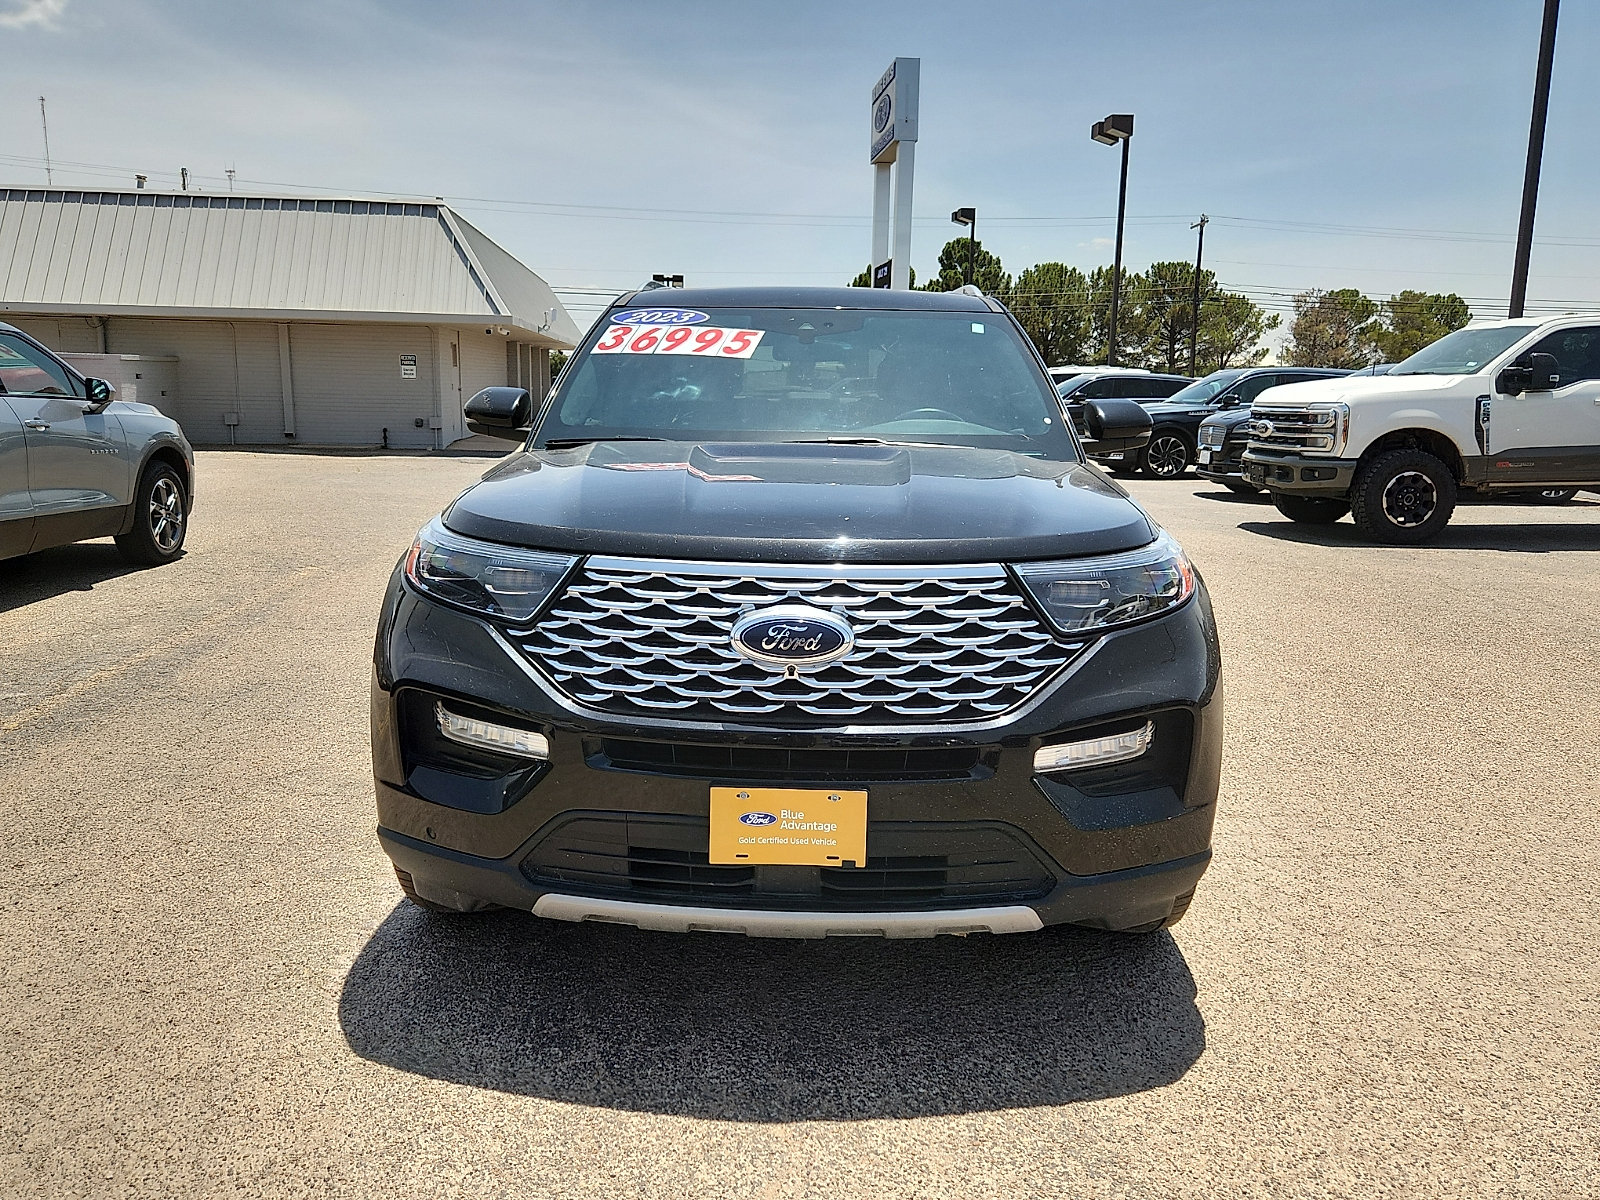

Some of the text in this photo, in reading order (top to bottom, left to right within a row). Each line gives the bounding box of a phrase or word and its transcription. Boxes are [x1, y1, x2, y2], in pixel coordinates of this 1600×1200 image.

[624, 311, 696, 323] 2023
[597, 326, 760, 355] 36995
[761, 623, 823, 651] Ford
[746, 813, 770, 825] Ford
[780, 809, 804, 820] Blue
[780, 820, 837, 832] Advantage
[738, 836, 756, 844] Gold
[757, 837, 788, 845] Certified
[811, 838, 837, 846] Vehicle
